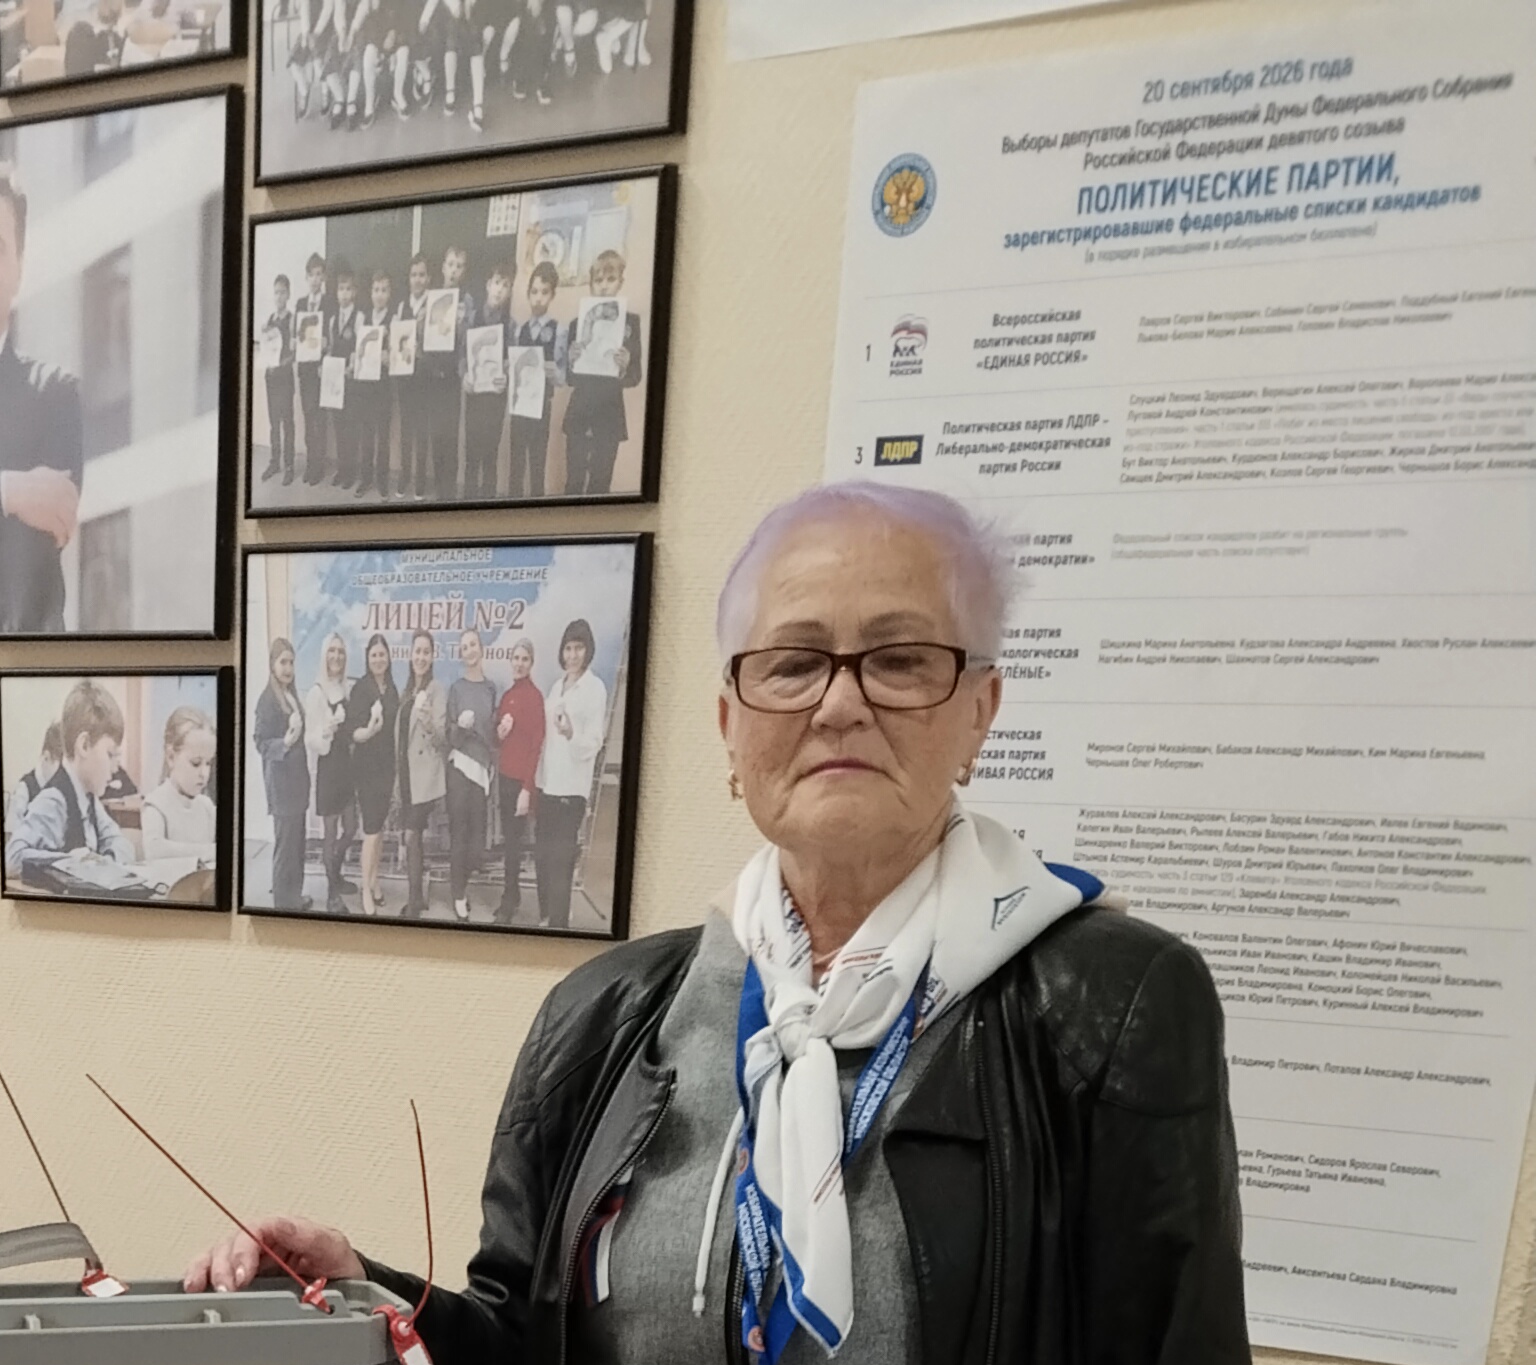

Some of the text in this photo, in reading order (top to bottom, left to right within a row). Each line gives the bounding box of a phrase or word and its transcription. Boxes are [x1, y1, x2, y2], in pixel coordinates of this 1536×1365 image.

[1142, 57, 1354, 104] 20 сентября 2026 года
[1001, 134, 1057, 154] Выборы
[1060, 125, 1131, 149] депутатов
[1135, 104, 1260, 141] Государственной
[1263, 102, 1307, 125] Думы
[1084, 117, 1406, 170] Российской Федерации девятого созыва
[1076, 152, 1401, 214] ПОЛИТИЧЕСКИЕ ПАРТИИ,
[1004, 218, 1175, 251] зарегистрировавшие
[1179, 205, 1298, 235] федеральные
[1304, 198, 1367, 219] списки
[1371, 185, 1481, 212] кандидатов
[992, 310, 1082, 328] Всероссийская
[973, 331, 1097, 349] политическая партия
[976, 350, 1088, 370] «ЕДИНАЯ РОССИЯ»
[942, 414, 1101, 434] Политическая партия ЛДПР
[854, 446, 863, 465] 3
[935, 437, 1111, 457] Либерально-демократическая
[978, 459, 1061, 476] партия России
[1033, 534, 1073, 548] партия
[362, 590, 465, 631] ЛИЦЕЙ
[1023, 628, 1061, 641] партия
[1002, 648, 1079, 659] кологическая
[1008, 750, 1046, 762] партия
[1008, 768, 1054, 781] РОССИЯ
